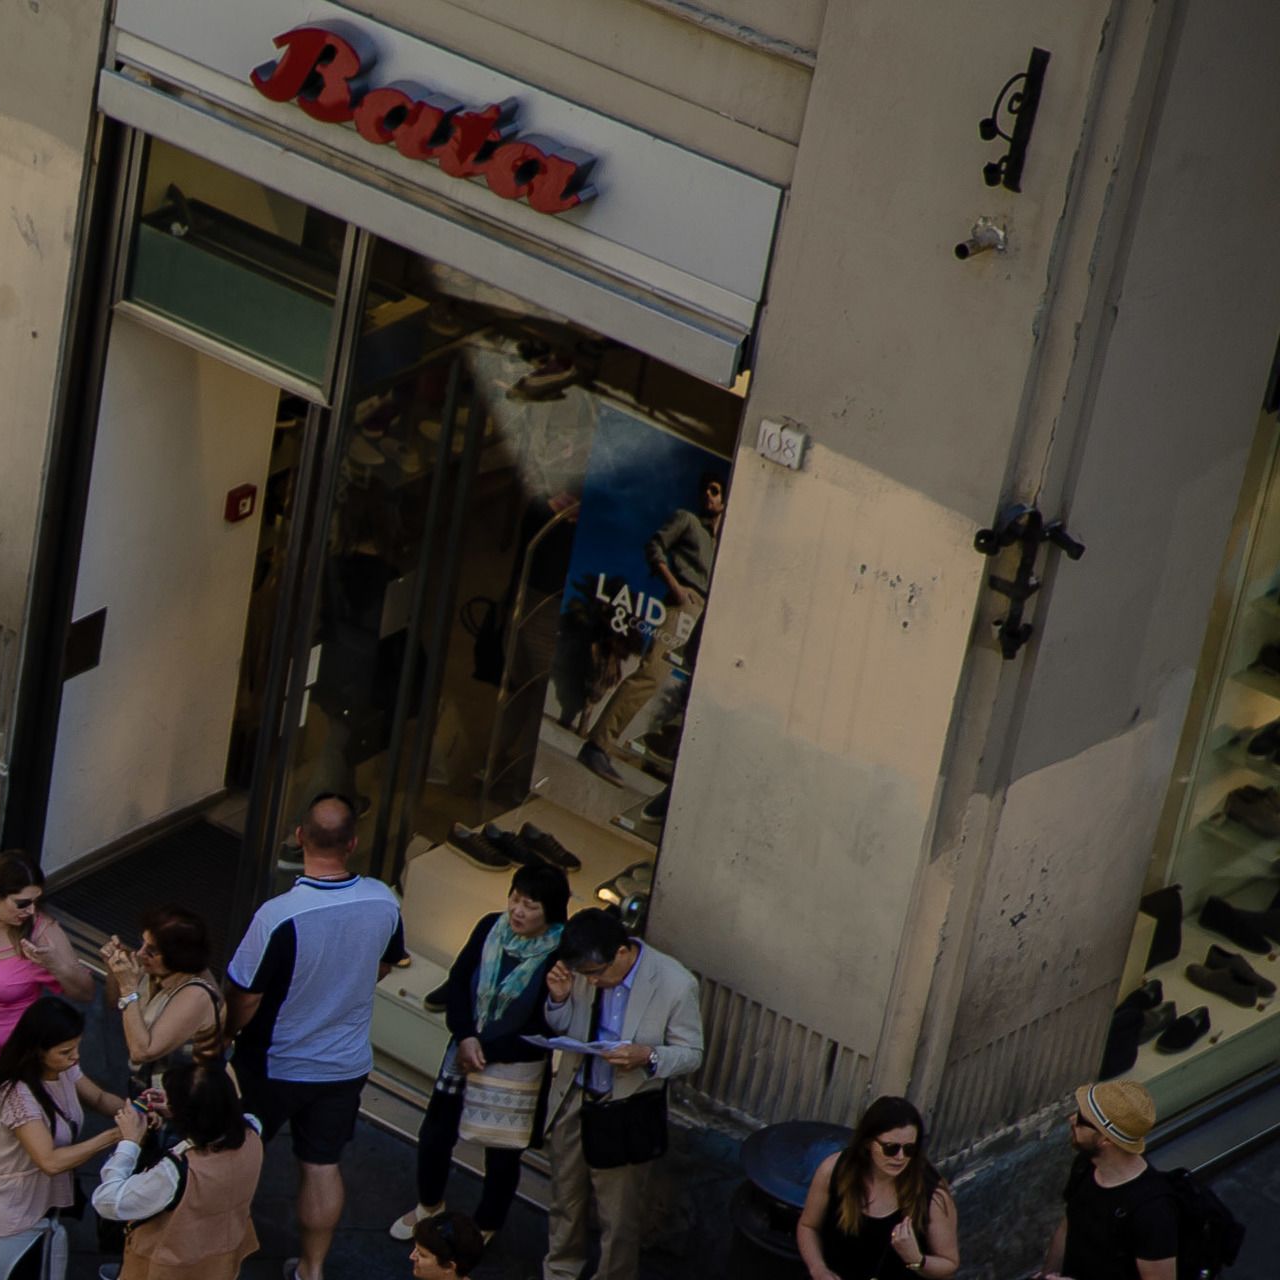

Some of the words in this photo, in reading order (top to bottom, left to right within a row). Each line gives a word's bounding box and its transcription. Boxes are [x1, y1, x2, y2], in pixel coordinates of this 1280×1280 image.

[250, 22, 598, 214] Bata
[762, 429, 796, 458] 108
[595, 572, 667, 627] LAID
[610, 606, 629, 637] &
